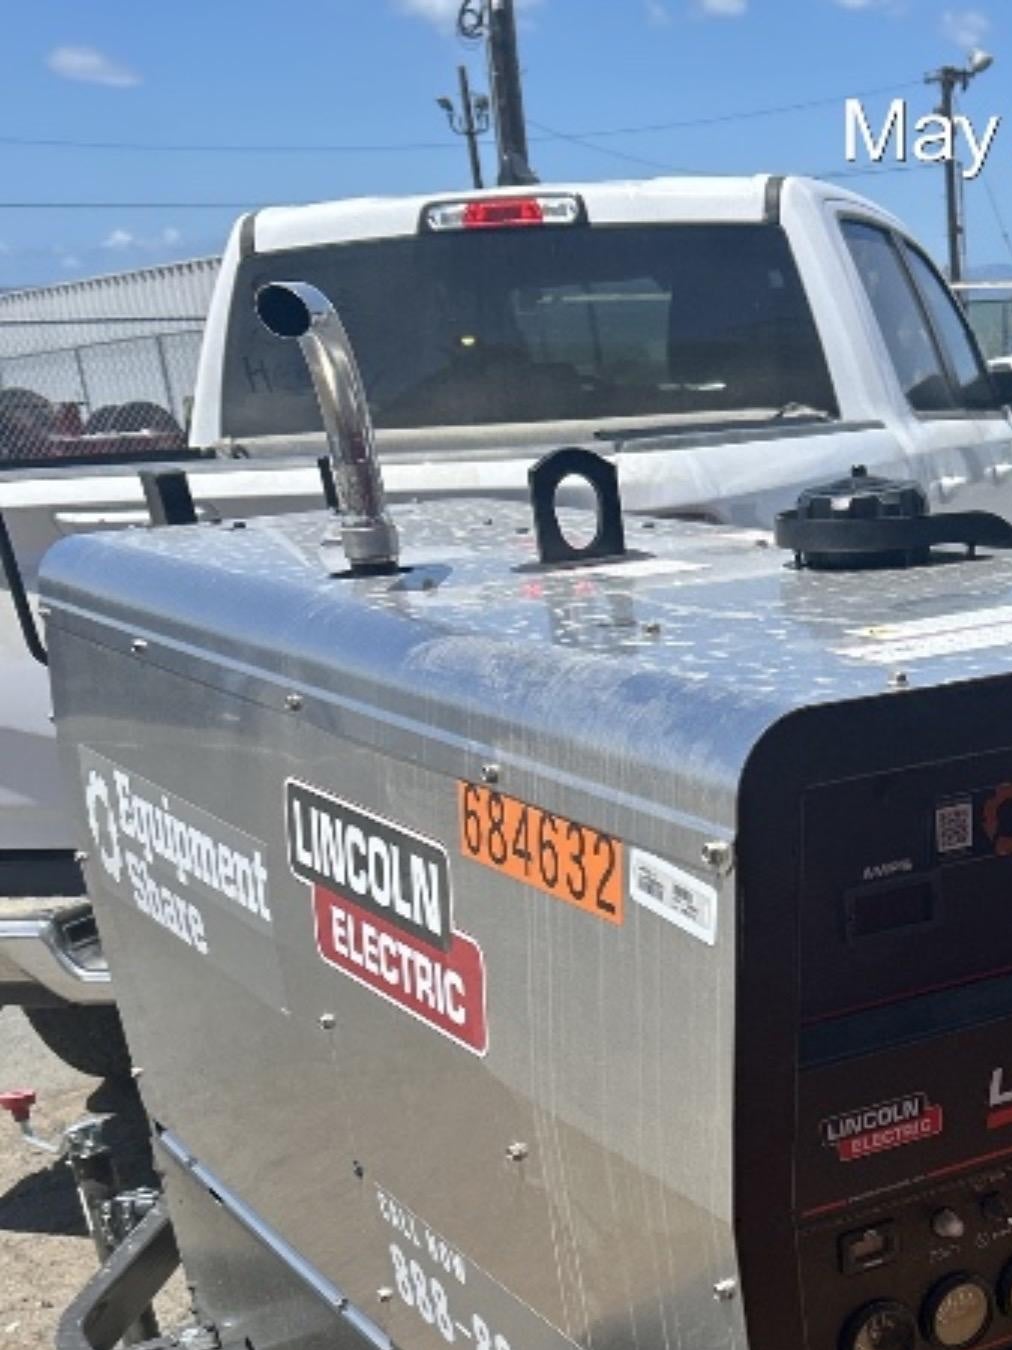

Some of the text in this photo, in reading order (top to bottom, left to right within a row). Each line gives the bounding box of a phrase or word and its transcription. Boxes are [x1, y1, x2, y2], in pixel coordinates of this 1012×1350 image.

[113, 769, 272, 923] Equipment
[125, 850, 209, 956] Share
[292, 798, 444, 936] LINCOLN
[463, 784, 618, 916] 684632
[330, 904, 467, 1026] ELECTRIC
[827, 1097, 919, 1141] LINCOLN
[851, 1118, 932, 1153] ELECTRIC
